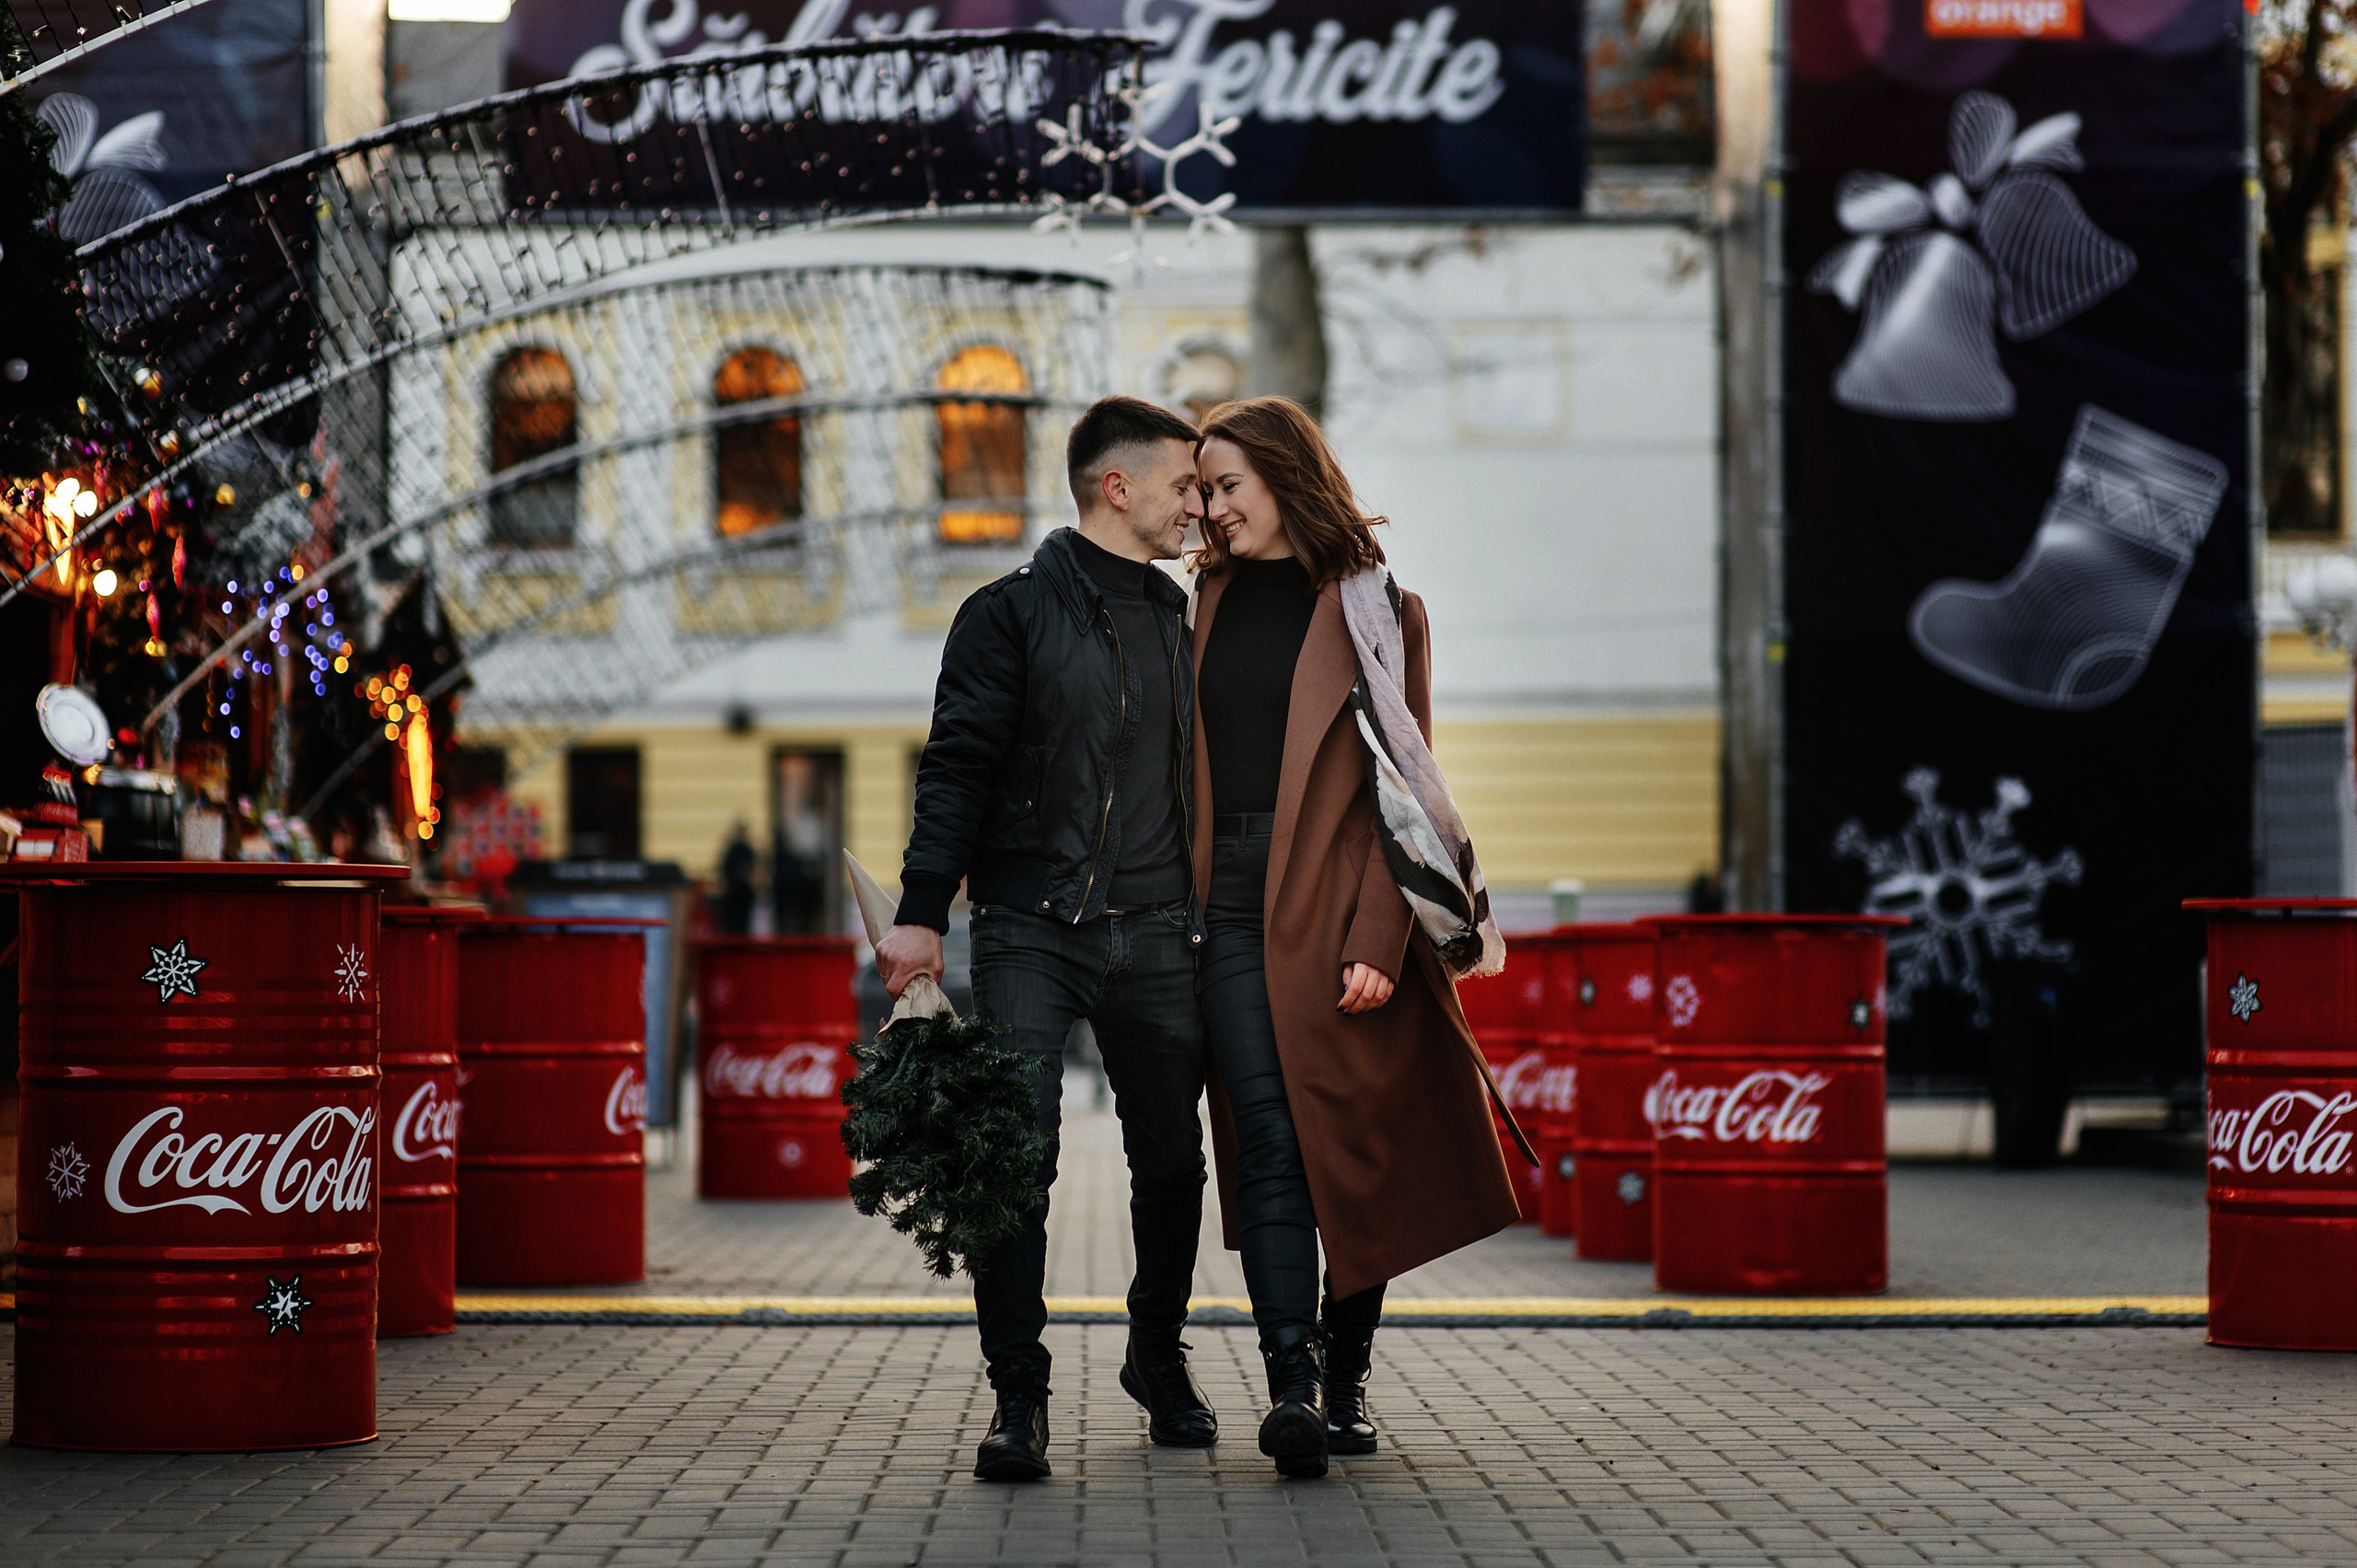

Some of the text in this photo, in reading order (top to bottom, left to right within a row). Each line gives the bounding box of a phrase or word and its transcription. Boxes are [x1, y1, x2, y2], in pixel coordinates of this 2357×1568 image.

[1929, 0, 2069, 37] orange
[1092, 0, 1506, 138] Fericite
[706, 1041, 839, 1098] Coca-Cola
[104, 1106, 377, 1216] Coca-Cola
